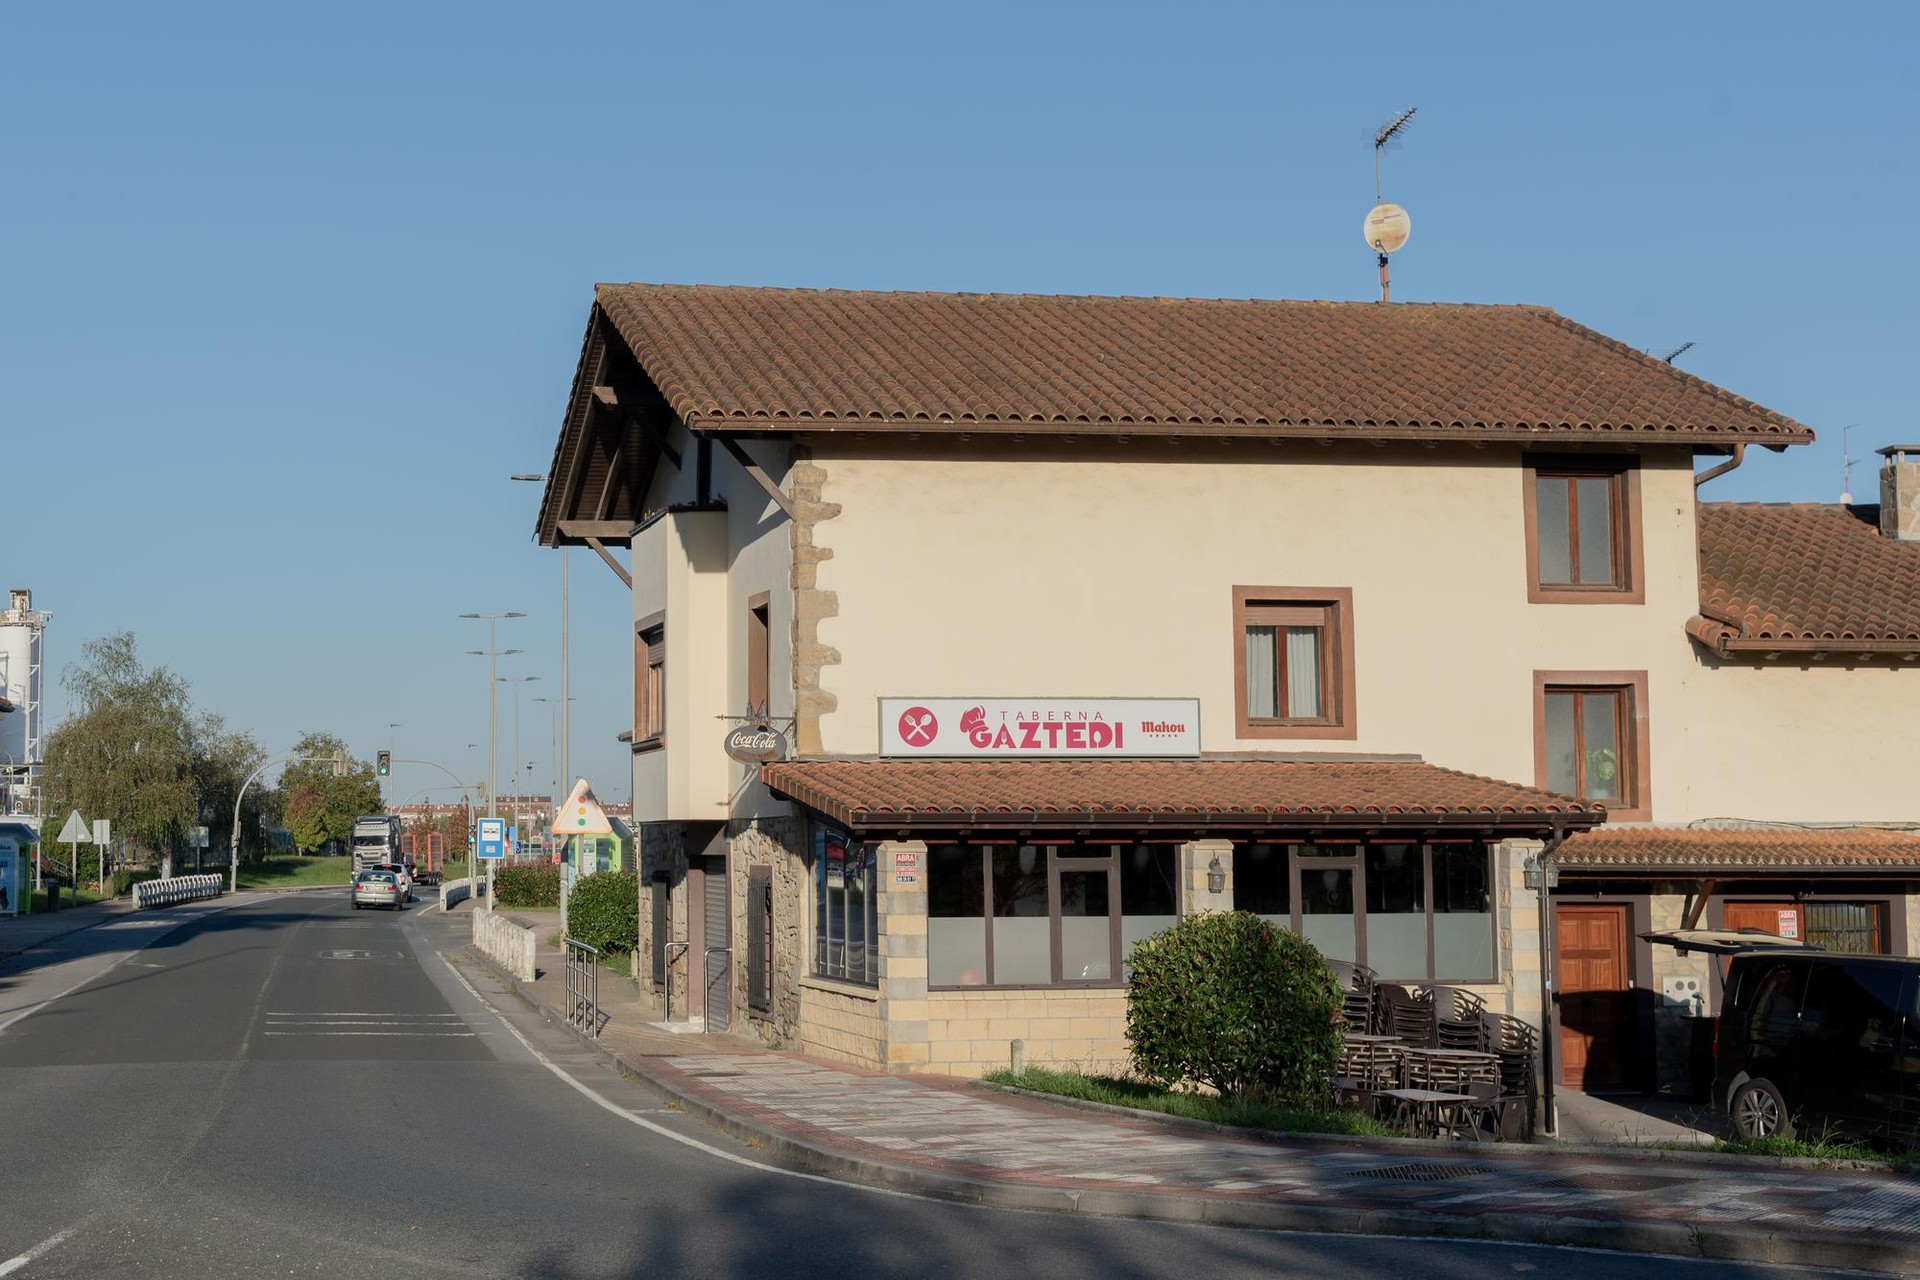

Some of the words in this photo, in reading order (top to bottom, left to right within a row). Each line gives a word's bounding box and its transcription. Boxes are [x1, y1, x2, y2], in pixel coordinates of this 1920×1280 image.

[1000, 711, 1103, 721] TABERNA
[1141, 721, 1185, 733] Mahou
[969, 722, 1123, 748] GAZTEDI
[897, 854, 915, 862] ABRA
